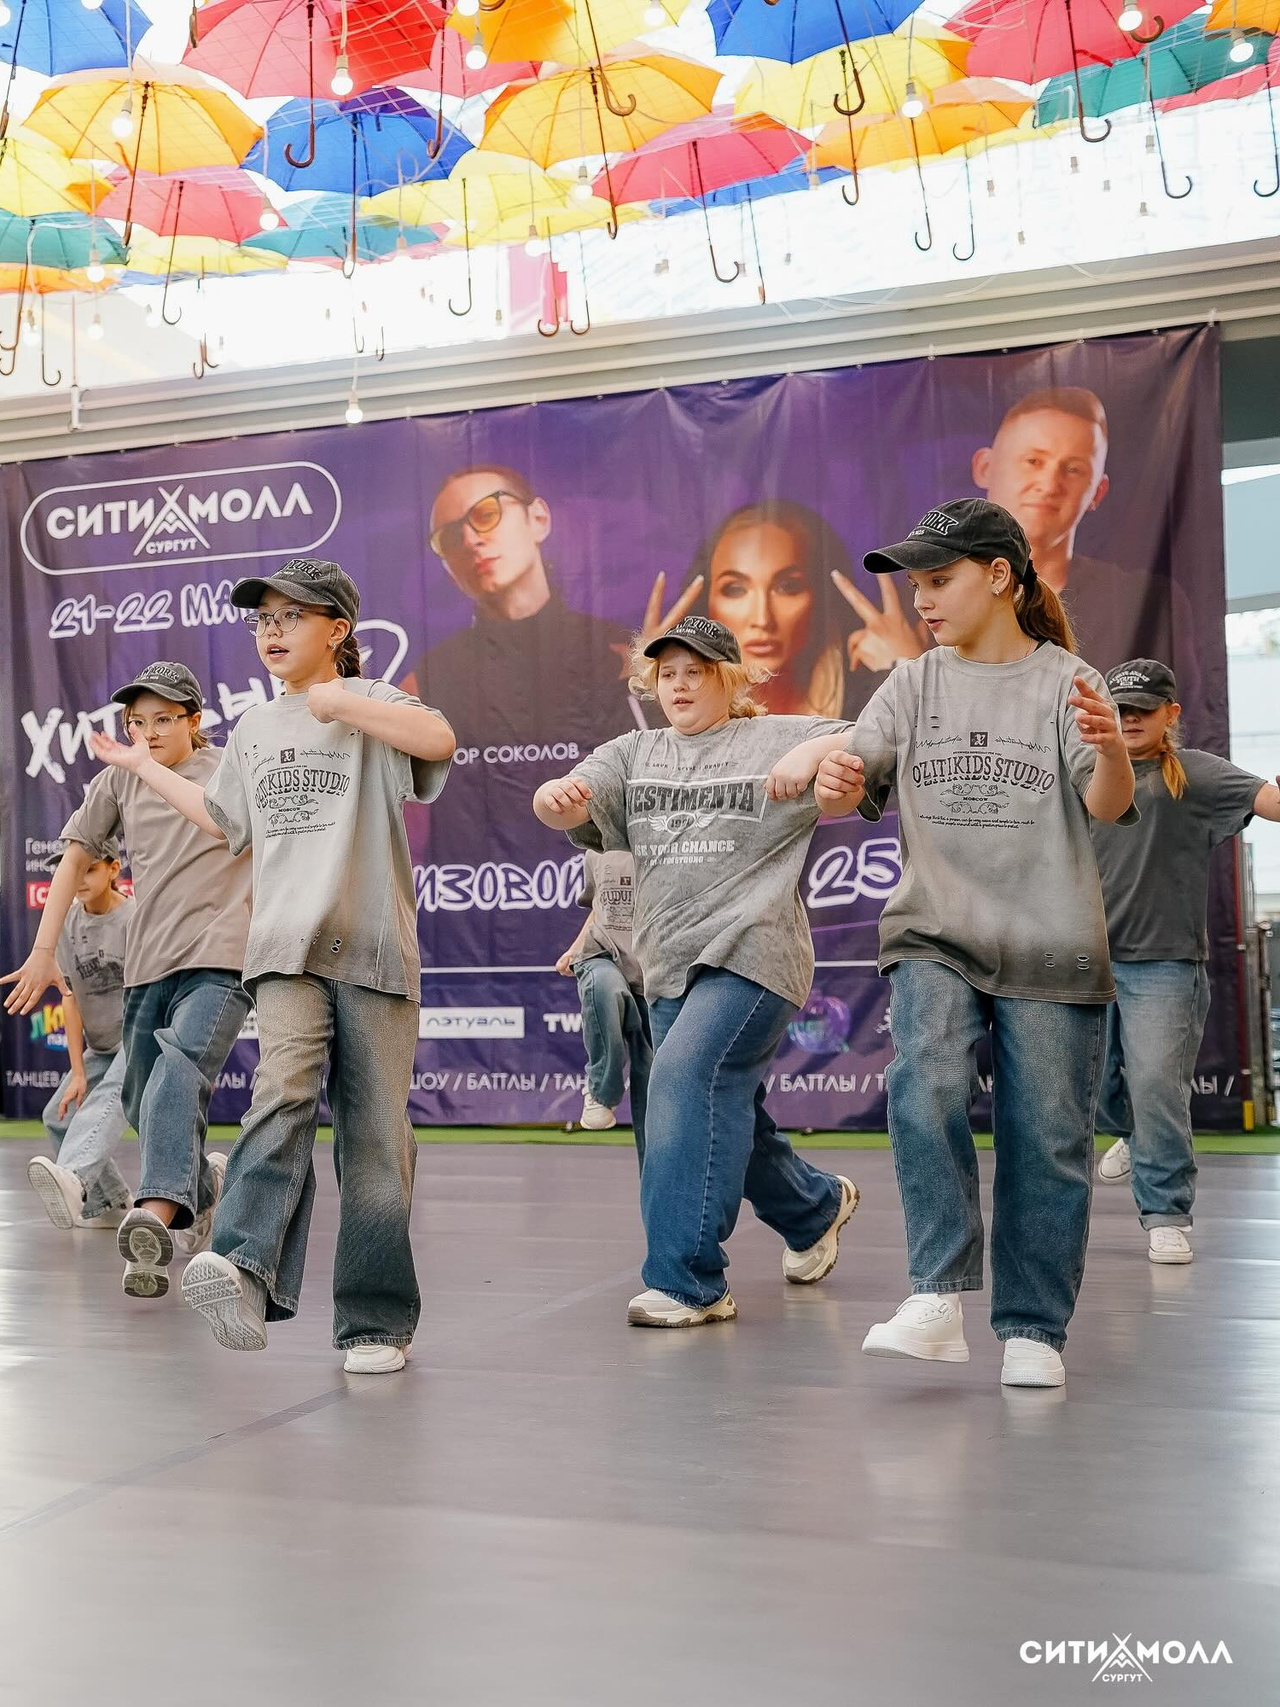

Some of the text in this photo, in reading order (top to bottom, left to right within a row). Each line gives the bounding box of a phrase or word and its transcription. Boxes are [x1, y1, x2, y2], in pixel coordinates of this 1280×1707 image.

[146, 537, 197, 555] СУРГУТ
[49, 590, 174, 639] 21-22
[483, 742, 580, 764] СОКОЛОВ
[302, 768, 351, 796] STUDIO
[993, 757, 1055, 793] STUDIO
[681, 840, 736, 855] CHANCE
[466, 1071, 536, 1091] БАТТЛЫ
[780, 1074, 856, 1092] БАТТЛЫ
